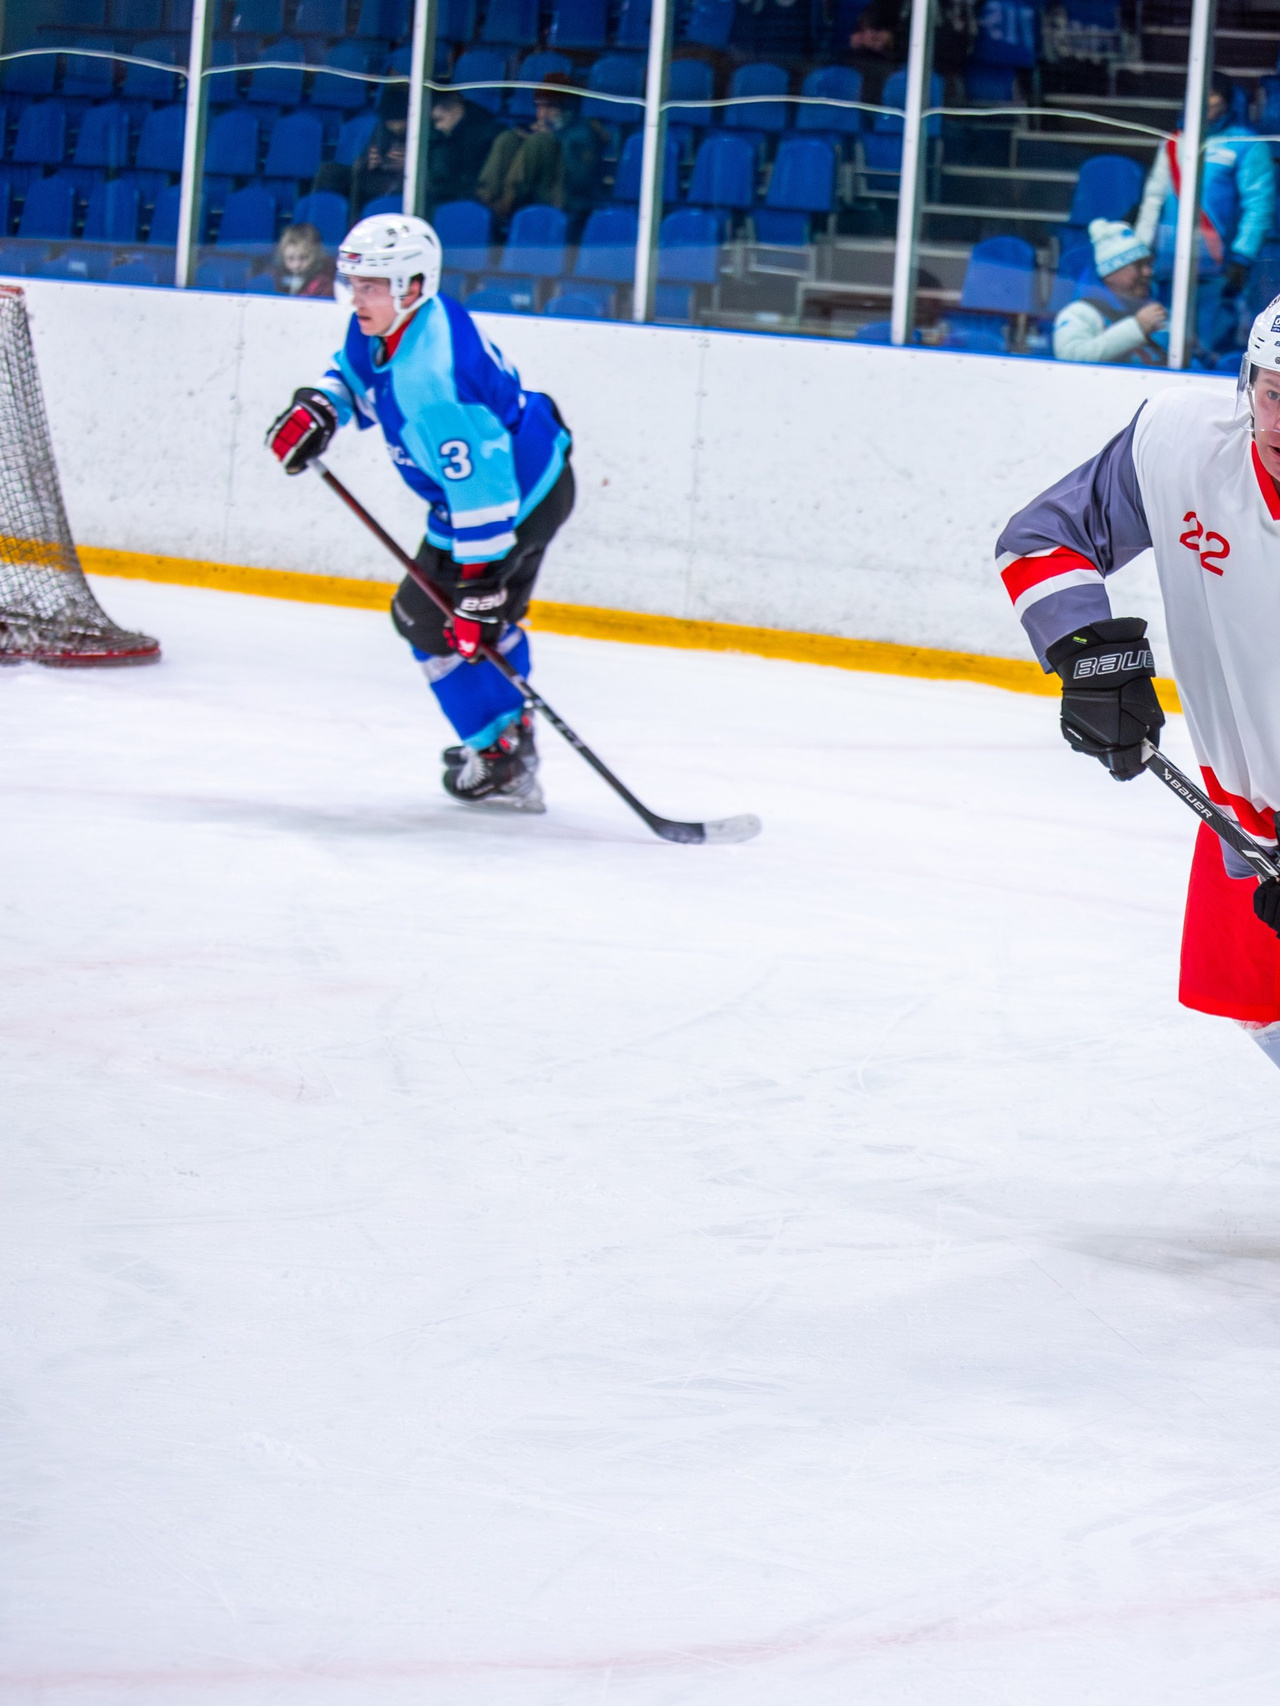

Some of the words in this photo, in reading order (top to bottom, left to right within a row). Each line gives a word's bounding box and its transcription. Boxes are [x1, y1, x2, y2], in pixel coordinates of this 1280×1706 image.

[440, 439, 473, 481] 3
[1179, 511, 1231, 577] 22
[1170, 779, 1213, 819] BAUER
